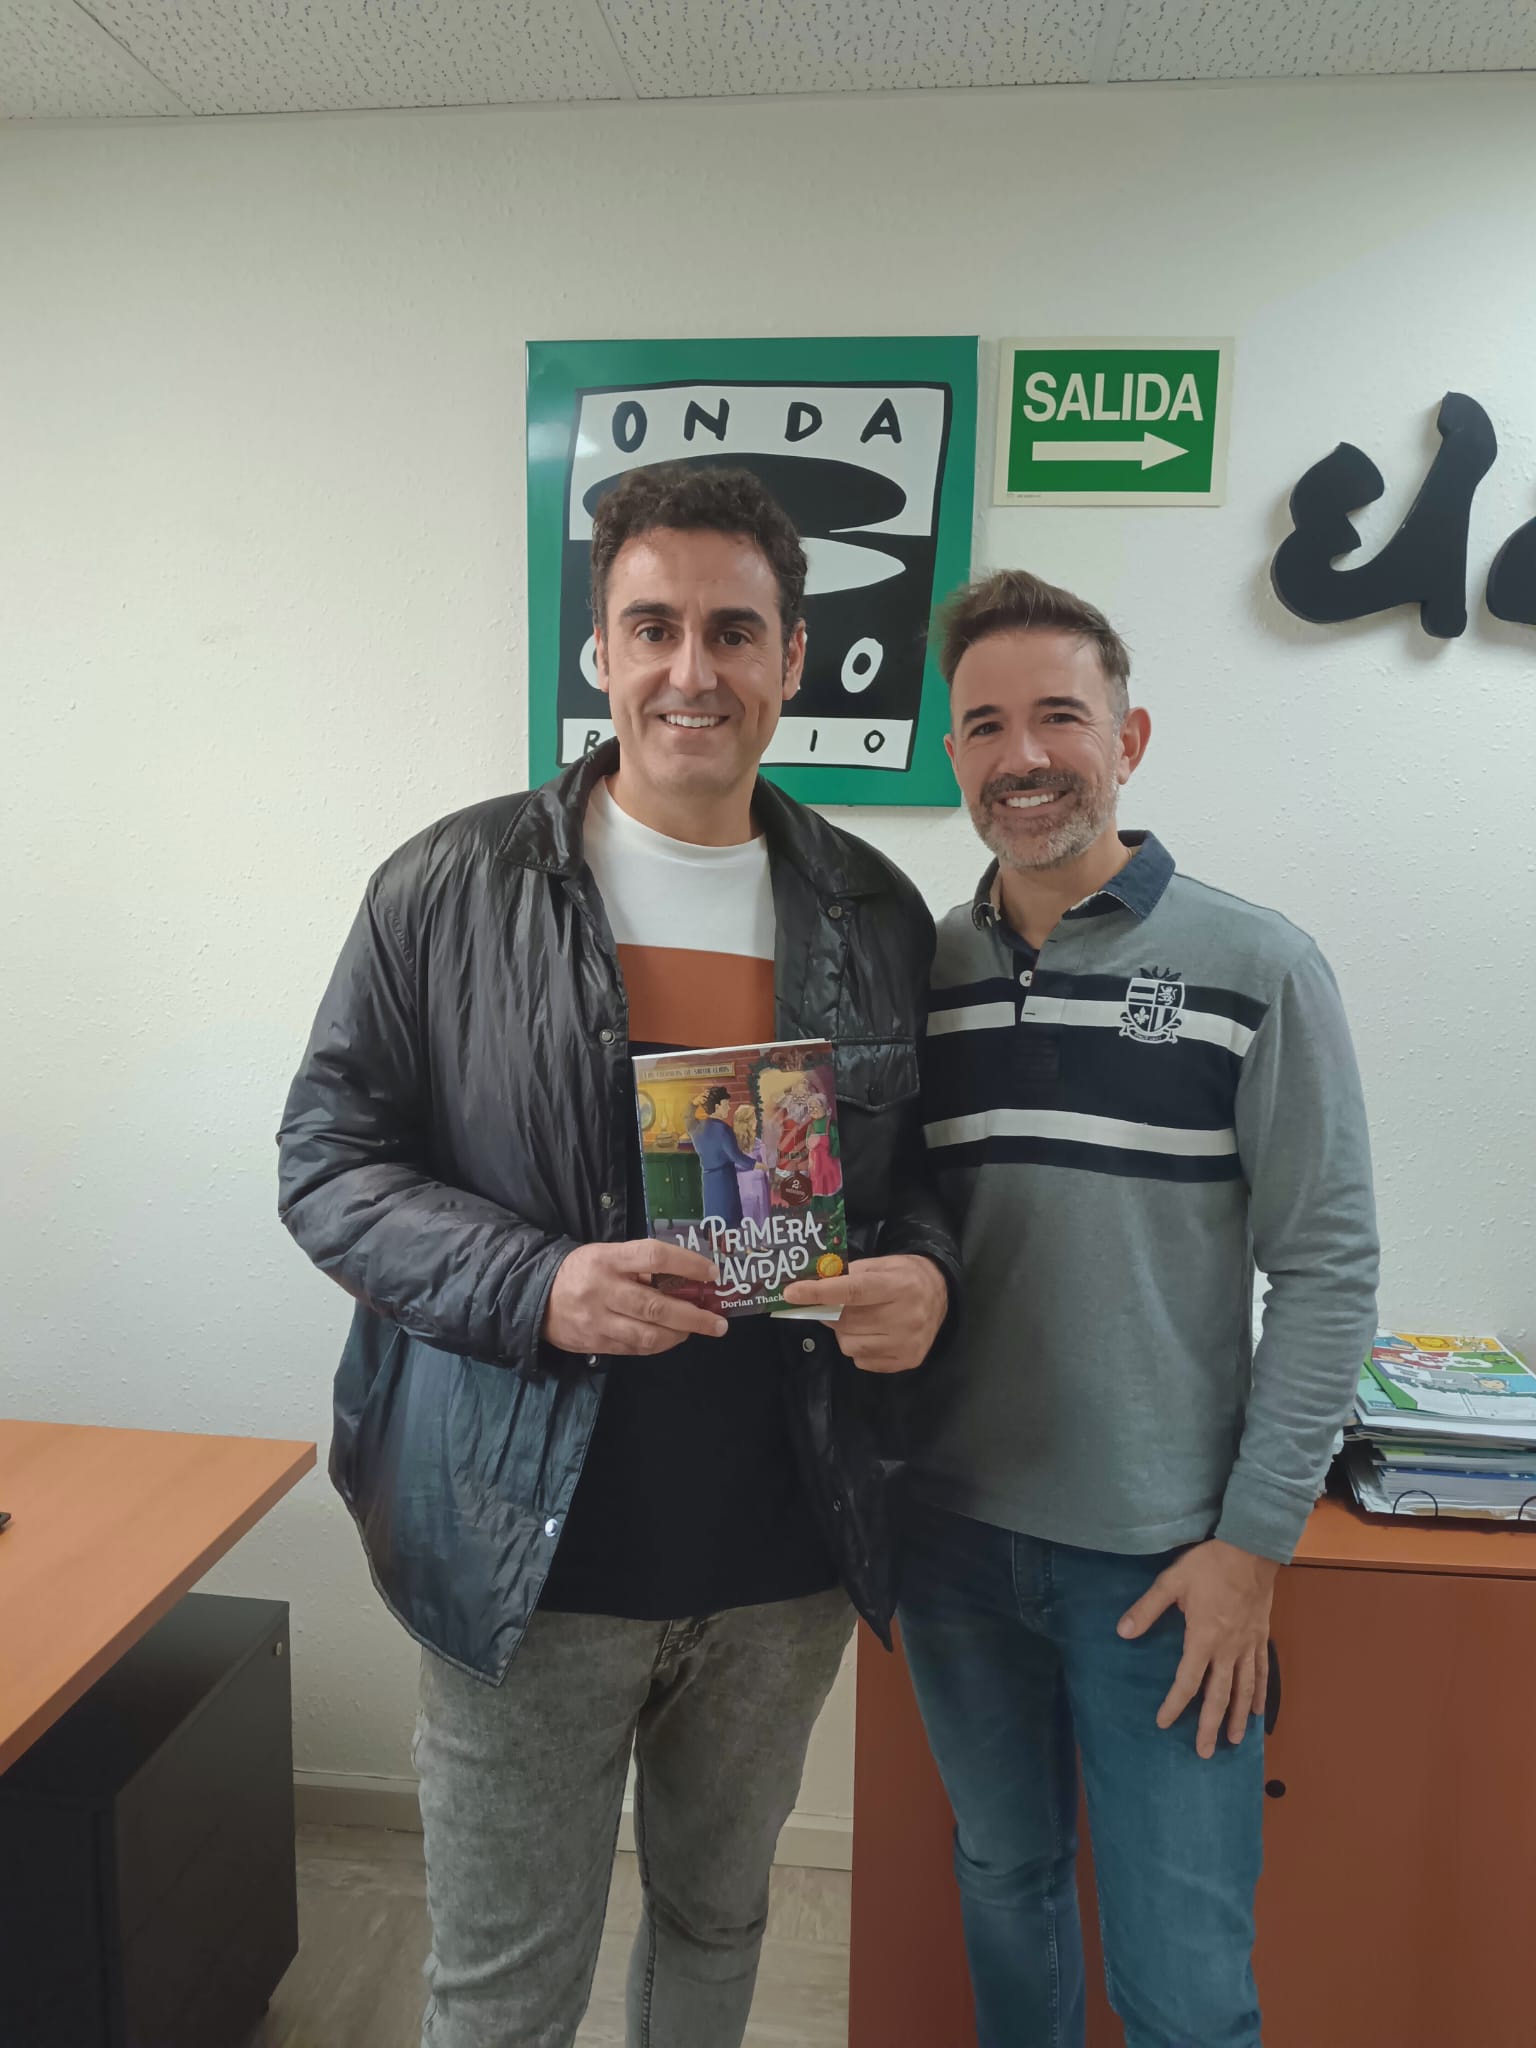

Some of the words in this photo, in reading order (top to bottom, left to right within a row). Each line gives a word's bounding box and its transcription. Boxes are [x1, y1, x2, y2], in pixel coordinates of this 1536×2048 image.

[1023, 371, 1204, 422] SALIDA
[612, 398, 902, 453] ONDA
[585, 729, 886, 753] RIO
[721, 1299, 753, 1309] Dorian
